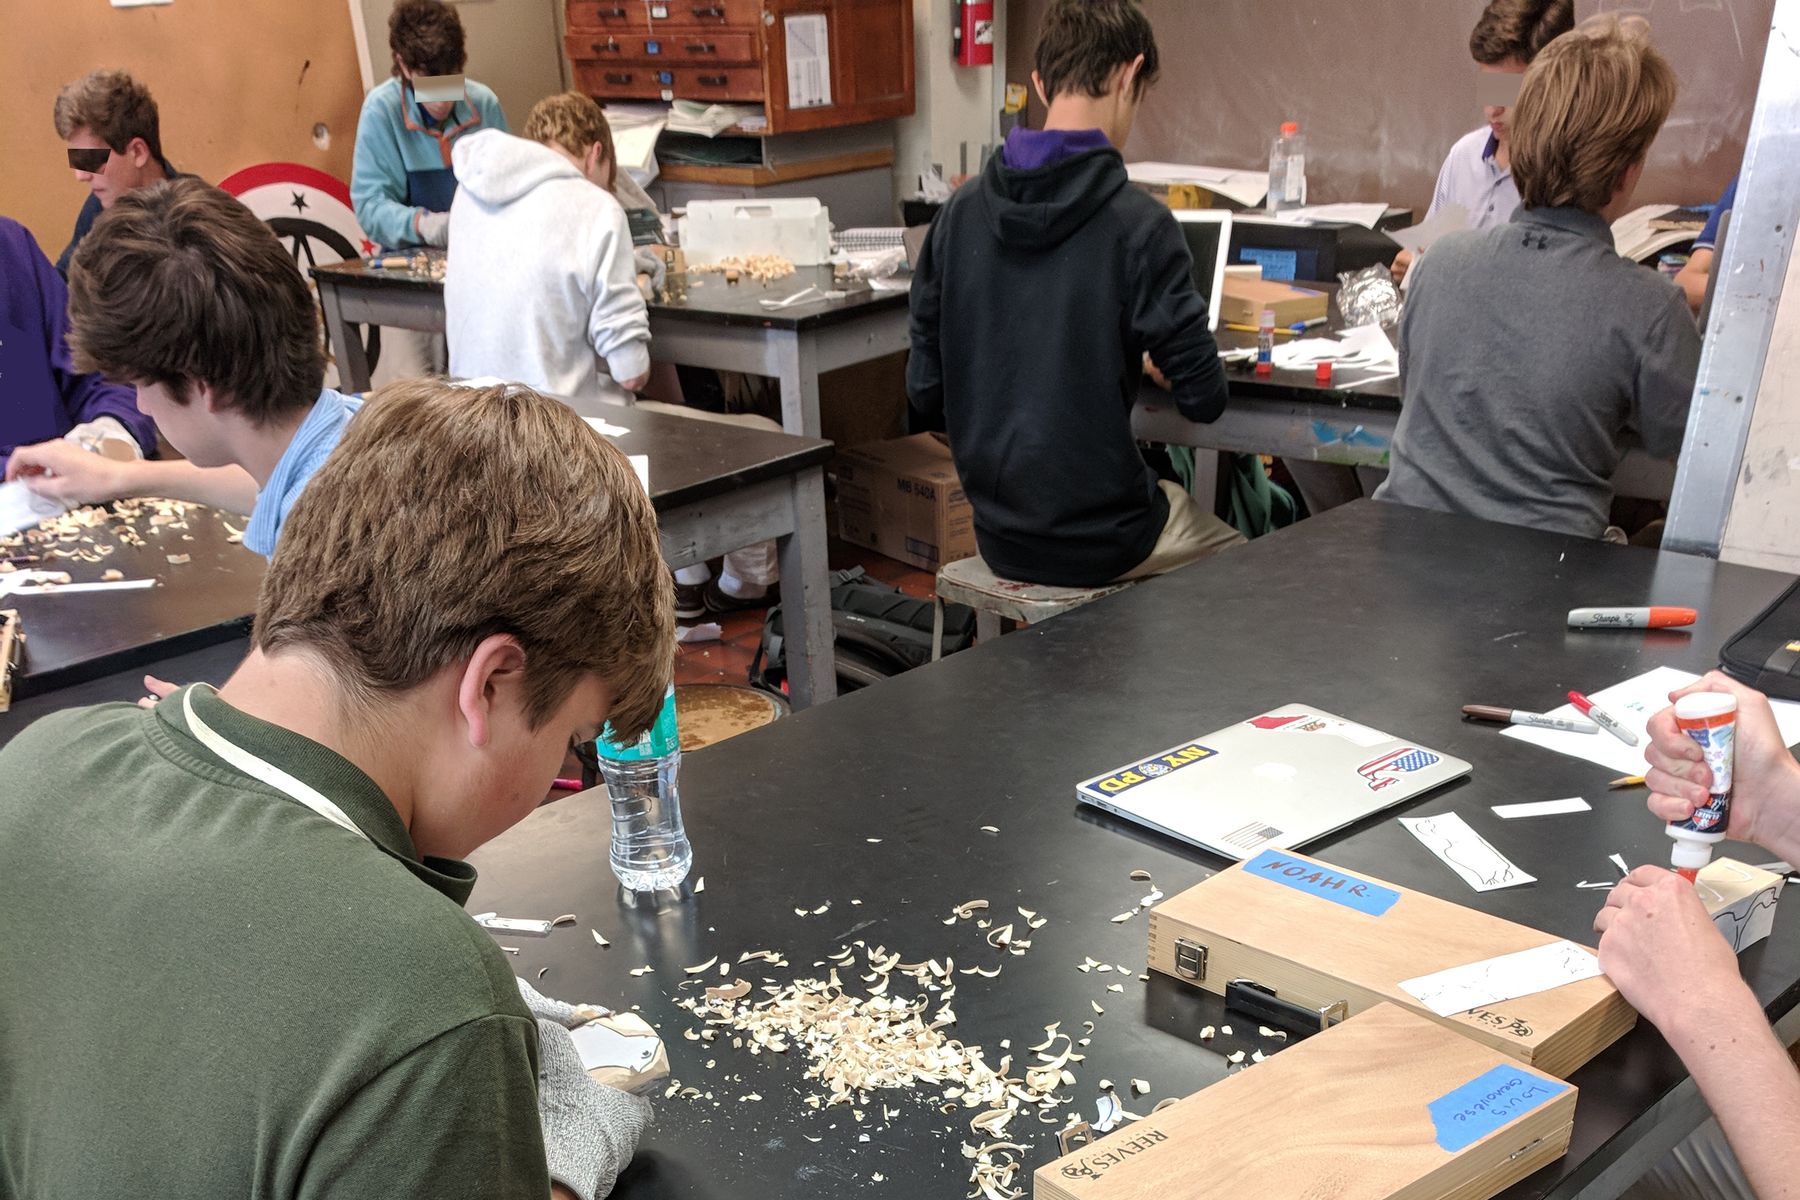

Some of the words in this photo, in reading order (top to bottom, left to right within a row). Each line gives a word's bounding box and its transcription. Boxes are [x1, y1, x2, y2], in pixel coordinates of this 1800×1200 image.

[1590, 613, 1622, 624] Sharpie
[1261, 860, 1347, 889] NOAH
[1092, 1130, 1168, 1169] REEVES
